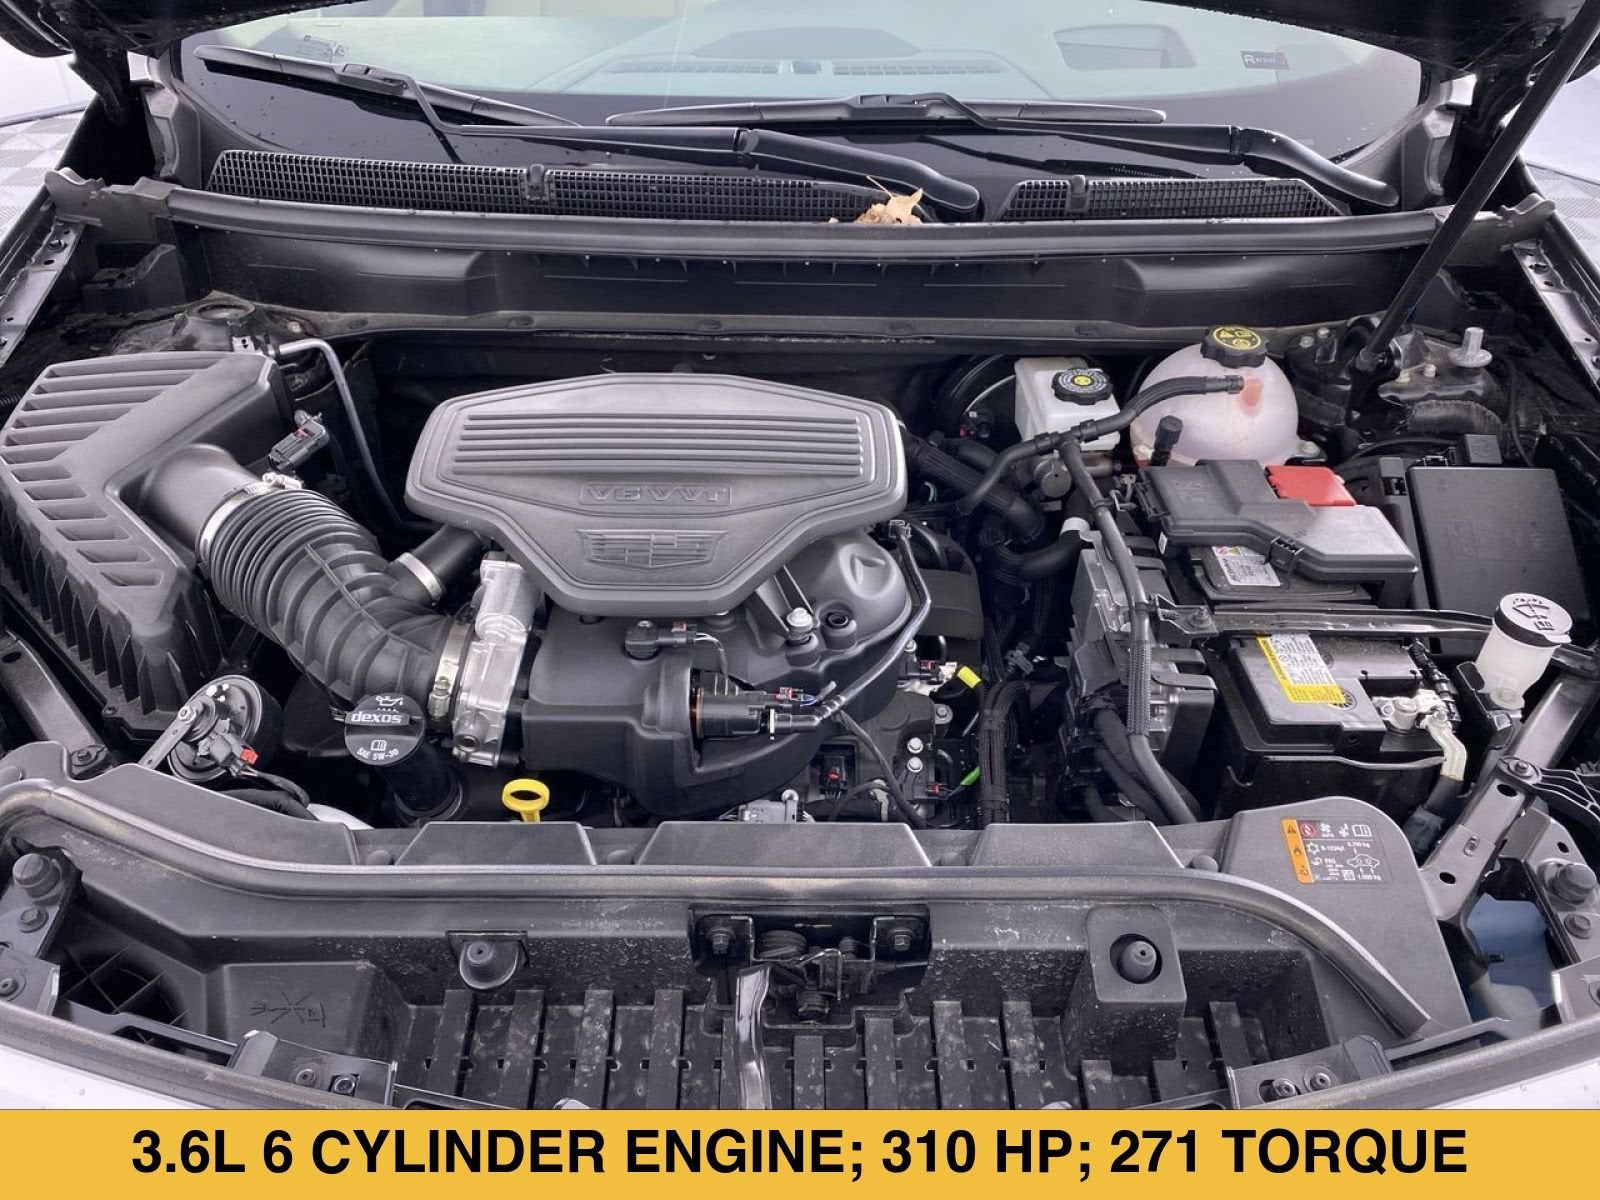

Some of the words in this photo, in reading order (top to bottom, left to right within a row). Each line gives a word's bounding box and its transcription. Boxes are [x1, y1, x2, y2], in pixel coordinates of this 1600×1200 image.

[586, 485, 641, 501] V6
[648, 485, 728, 501] VVT
[351, 711, 402, 723] dexos
[372, 748, 399, 760] 5W-30
